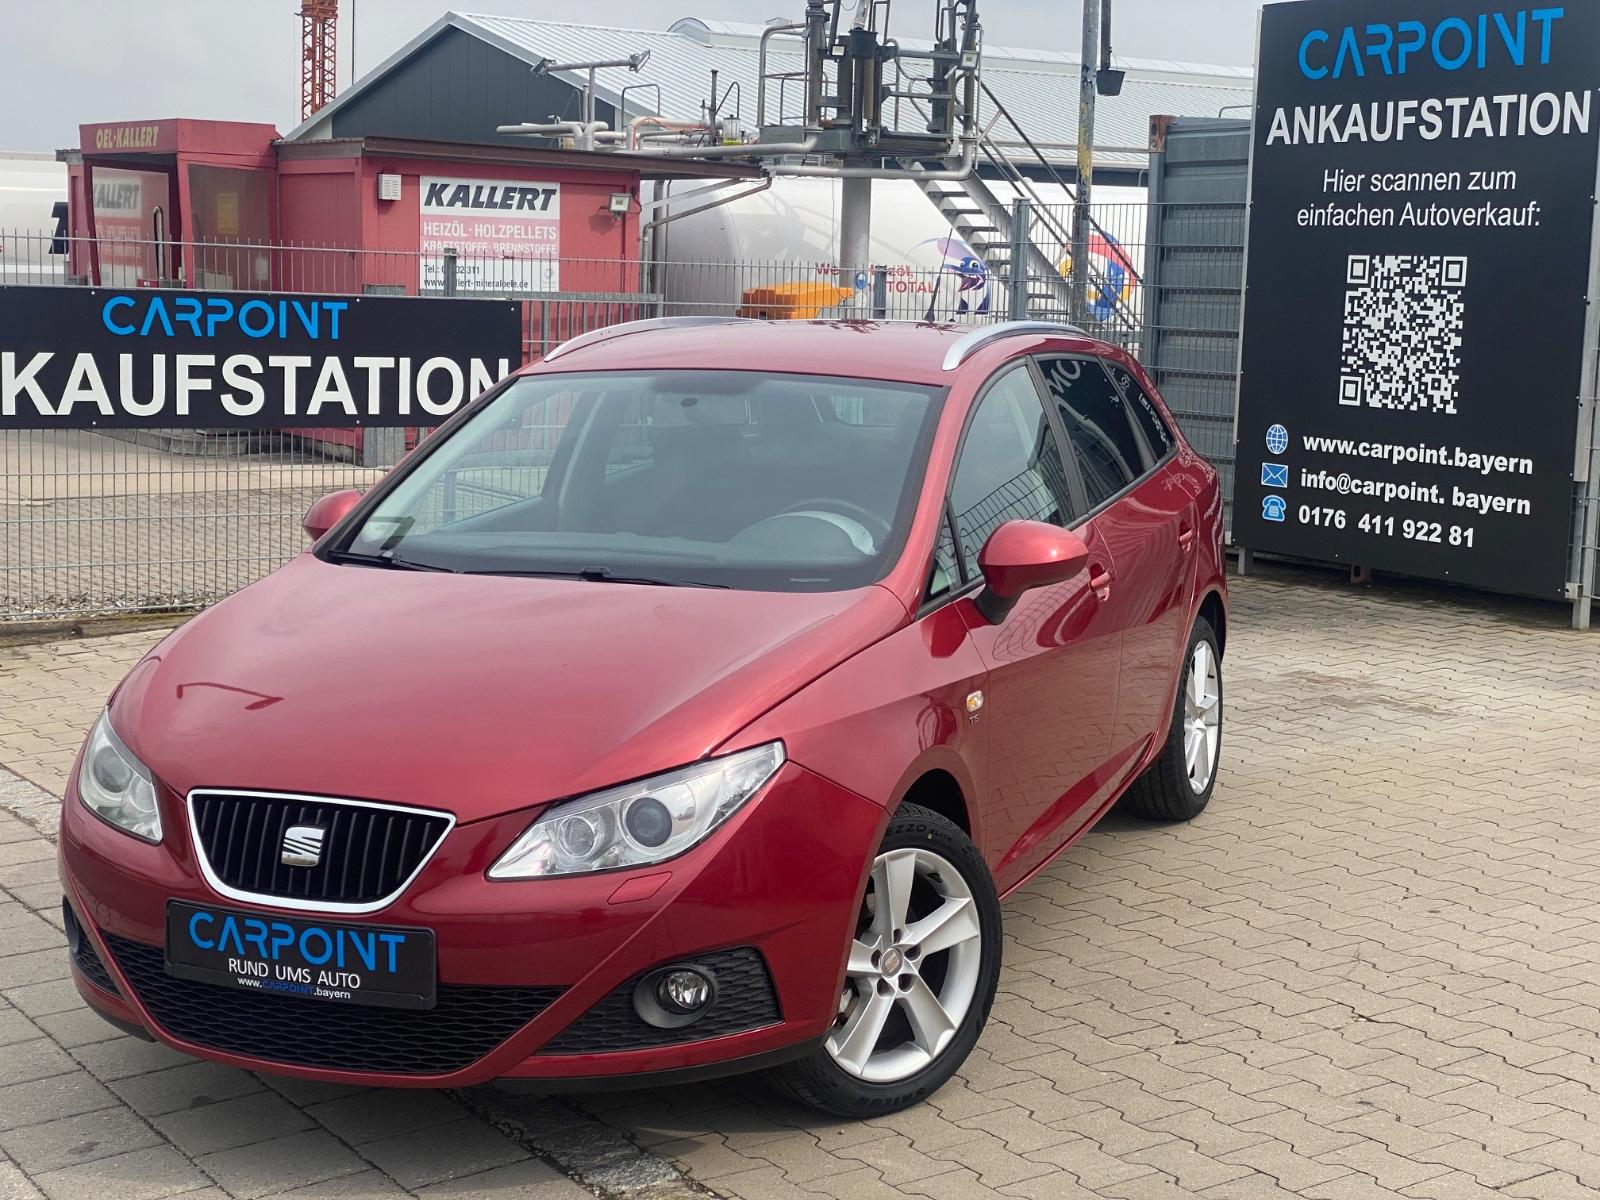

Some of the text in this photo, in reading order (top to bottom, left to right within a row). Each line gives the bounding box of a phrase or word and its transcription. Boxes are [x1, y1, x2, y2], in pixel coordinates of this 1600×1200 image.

[1298, 8, 1564, 80] CARPOINT
[1265, 90, 1592, 146] ANKAUFSTATION
[1323, 169, 1517, 193] Hier scannen zum
[424, 182, 557, 211] KALLERT
[1297, 200, 1541, 227] einfachen Autoverkauf:
[423, 220, 557, 240] HEIZÖL HOLZPELLETS
[423, 239, 557, 255] KRAFTSTOFFE BRENNSTOFFE
[102, 296, 347, 339] CARPOINT
[1303, 436, 1533, 475] www.carpoint.bayern
[1452, 486, 1531, 515] bayern
[1298, 505, 1474, 548] 0176 411 922 81
[189, 911, 405, 973] CARPOINT
[228, 958, 361, 989] RUND UMS AUTO
[237, 977, 351, 1000] www.CARPOINT.bayern
